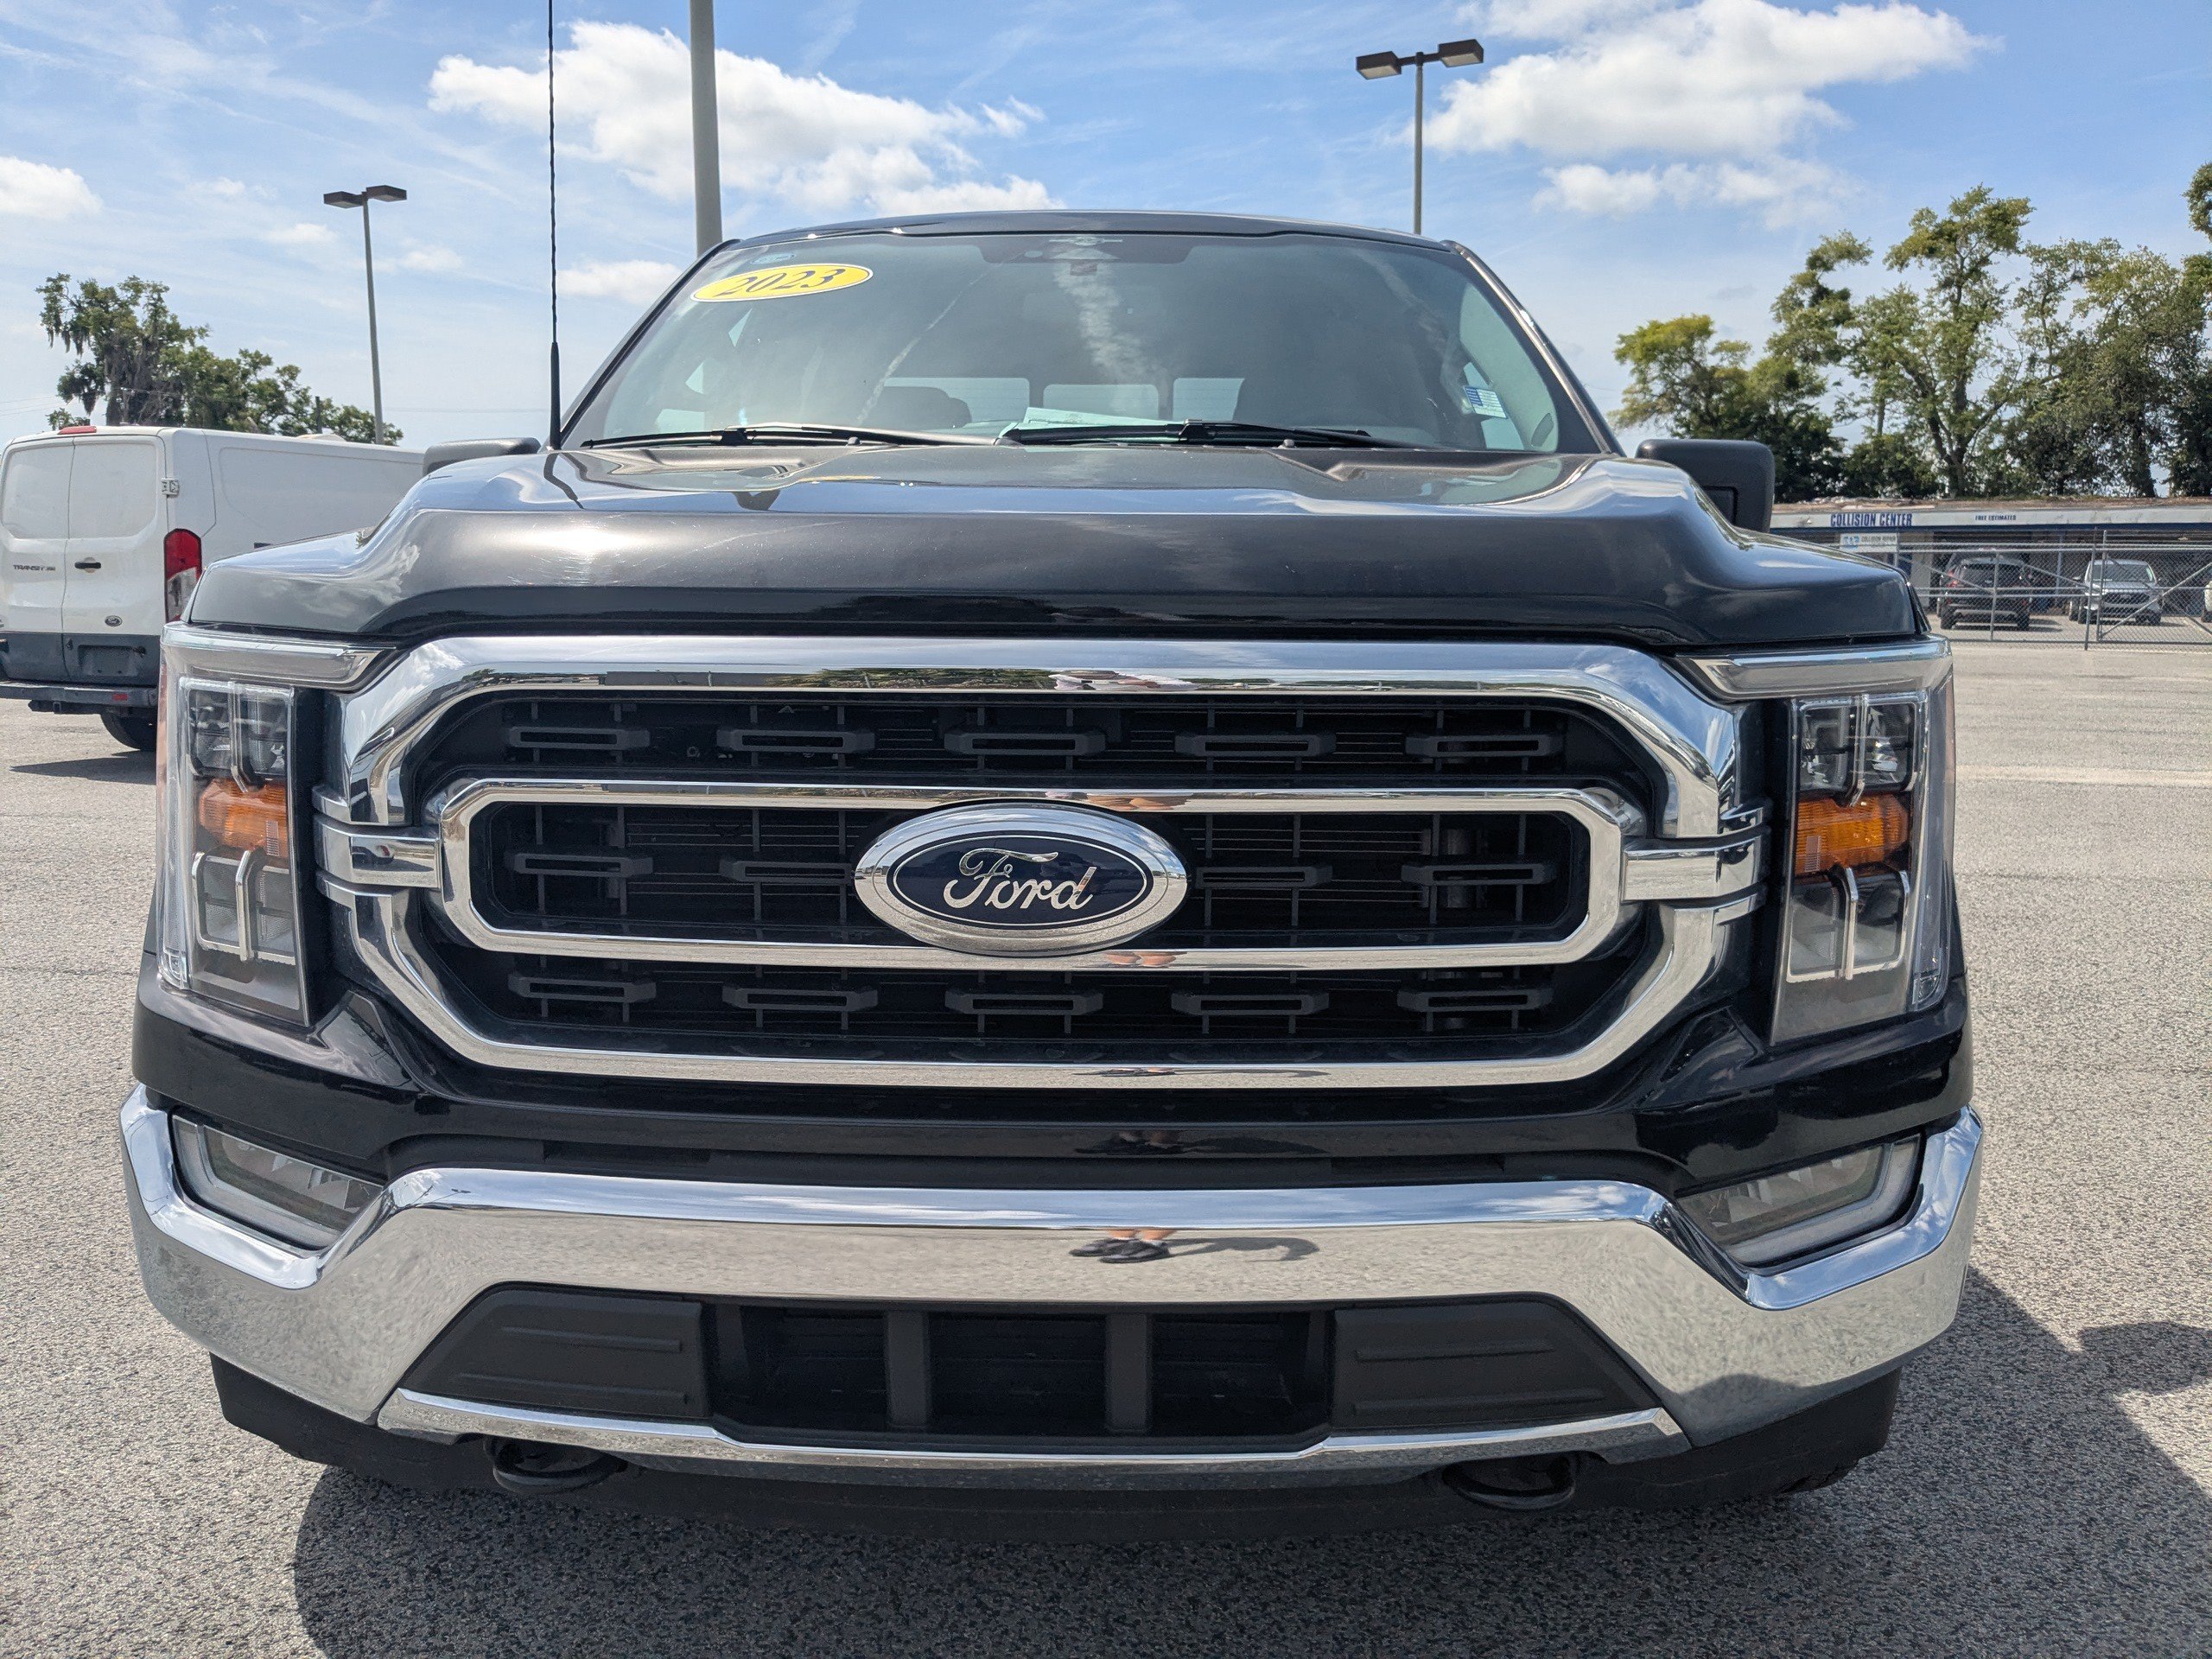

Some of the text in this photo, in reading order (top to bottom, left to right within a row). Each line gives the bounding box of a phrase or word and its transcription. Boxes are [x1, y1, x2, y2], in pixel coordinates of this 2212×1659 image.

[713, 269, 846, 297] 2023
[1830, 512, 1913, 526] COLLISION CENTER
[943, 848, 1097, 910] Ford
